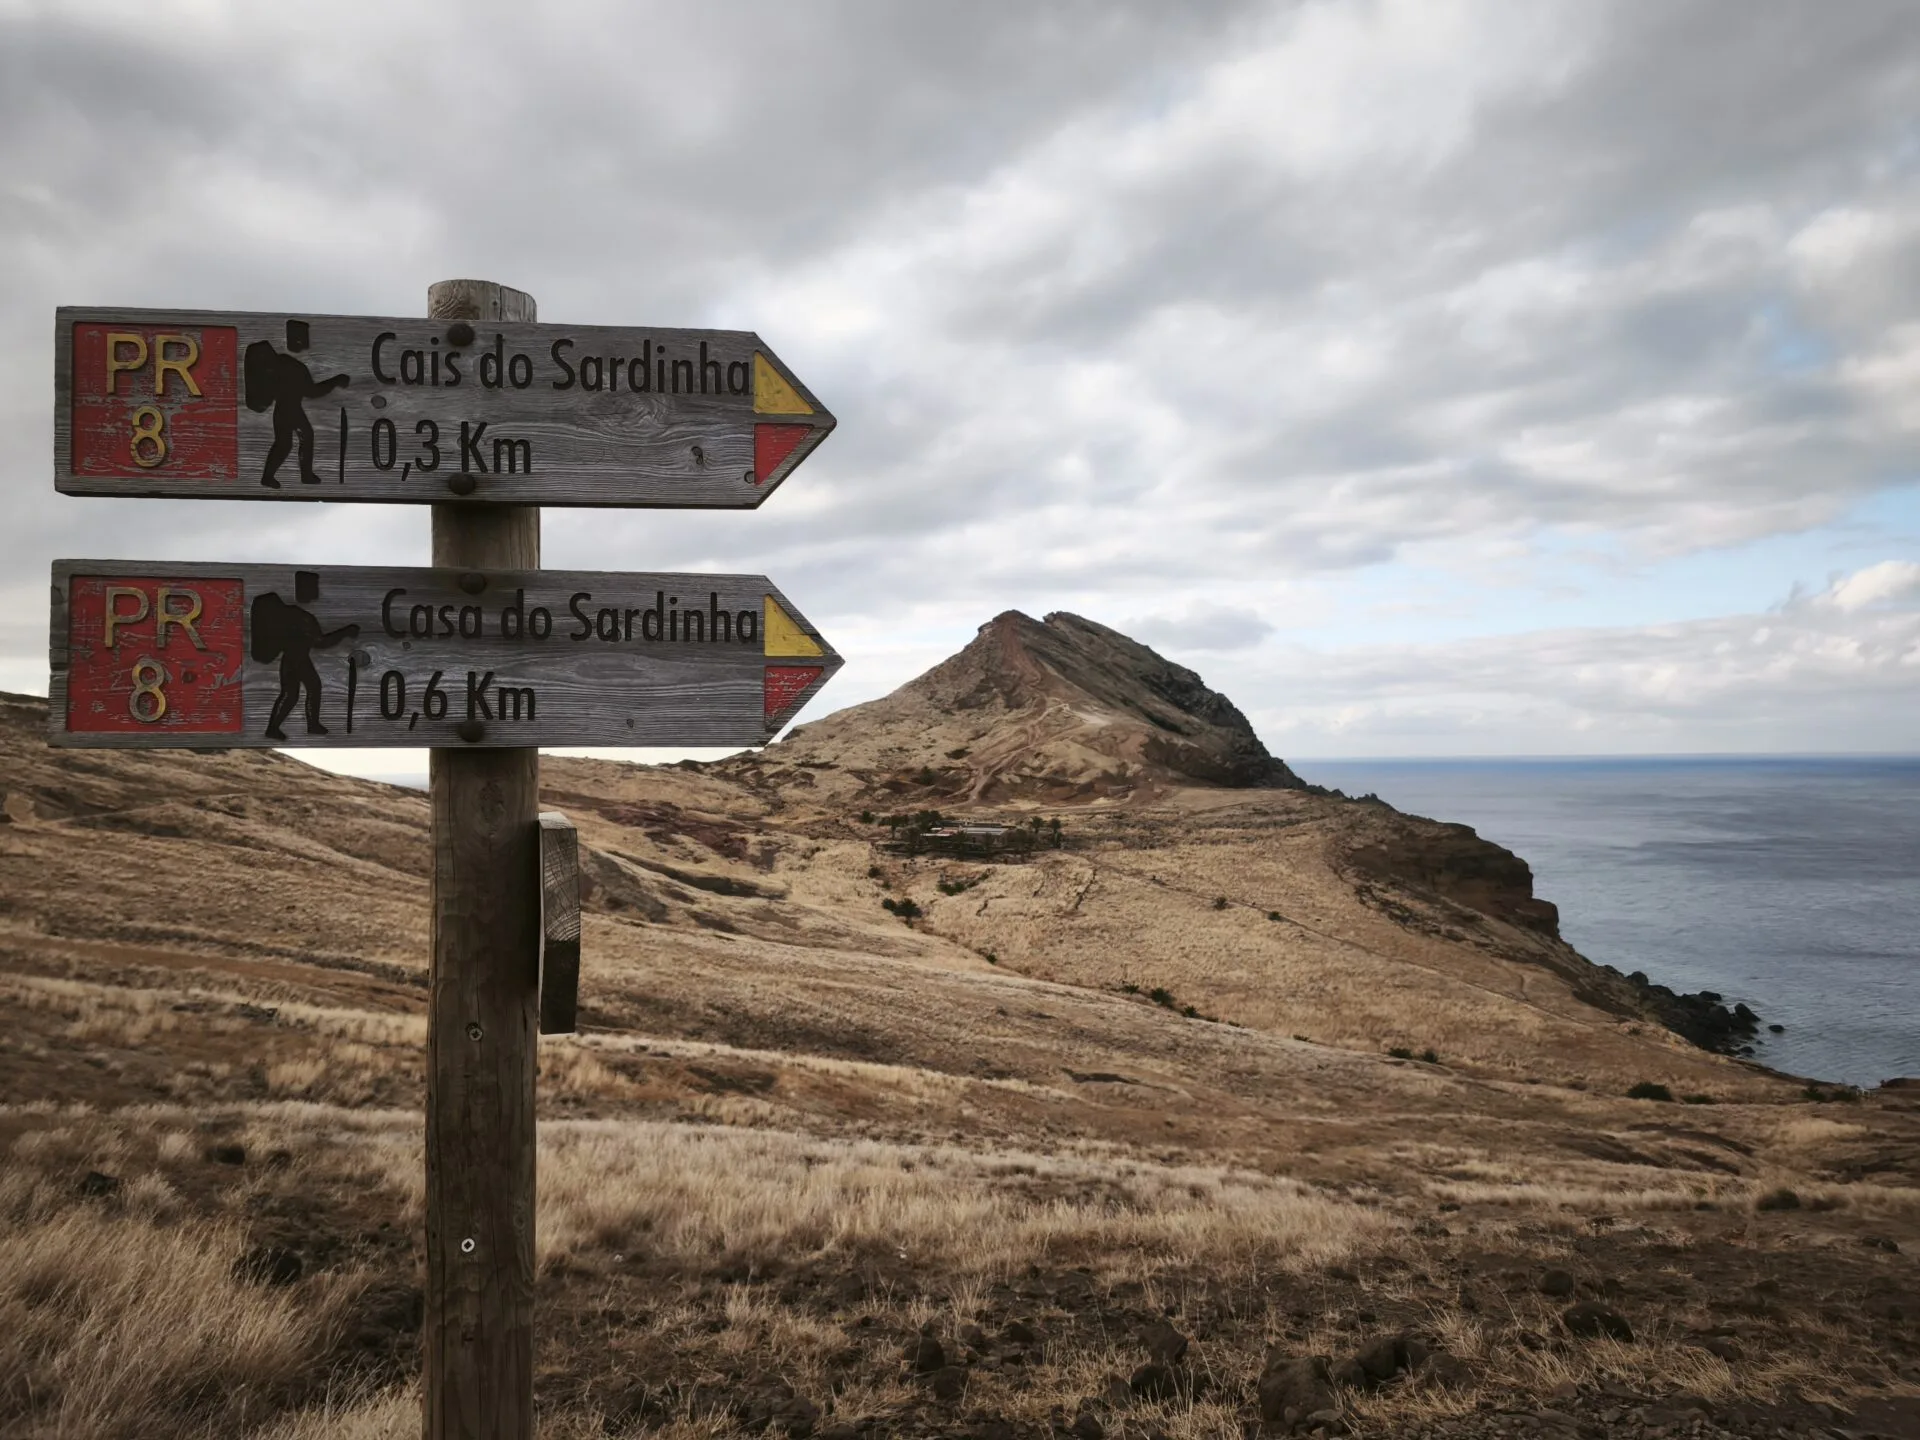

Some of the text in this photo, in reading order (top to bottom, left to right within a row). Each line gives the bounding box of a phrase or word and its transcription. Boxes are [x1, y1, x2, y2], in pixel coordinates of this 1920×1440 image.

[105, 332, 202, 397] PR
[371, 332, 751, 397] Cais do Sardinha
[130, 406, 168, 468] 8
[371, 418, 531, 482] 0,3 Km
[105, 586, 207, 650] PR
[381, 588, 758, 644] Casa do Sardinha
[129, 658, 167, 722] 8
[379, 670, 536, 731] 0,6 Km
